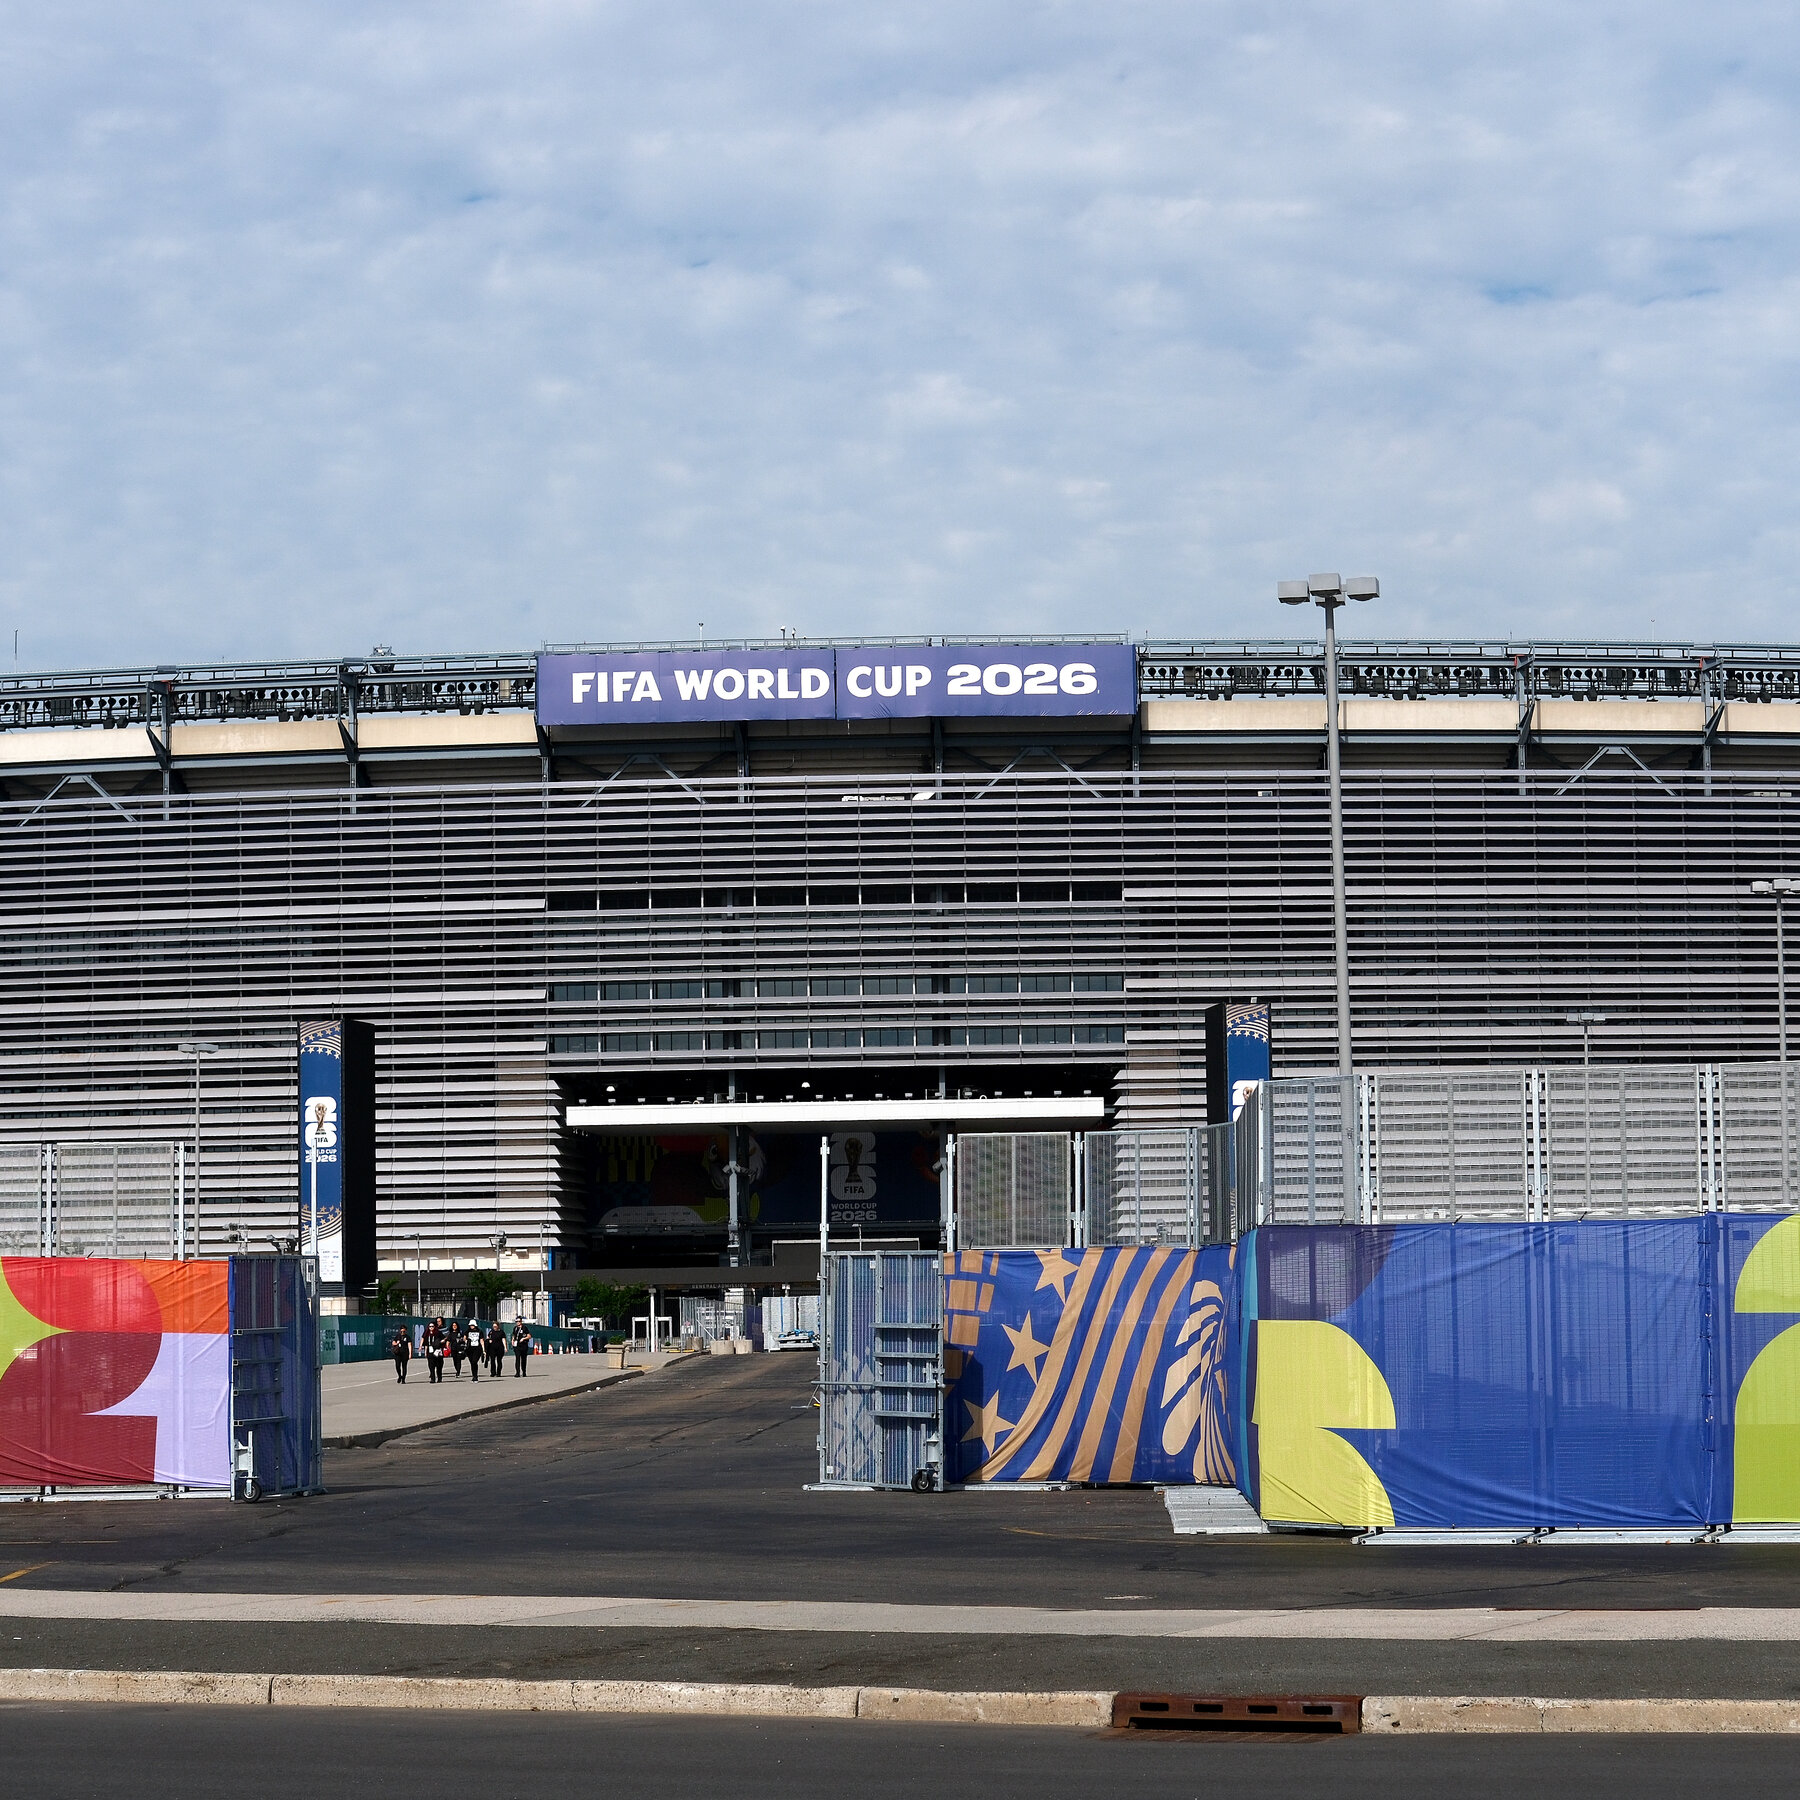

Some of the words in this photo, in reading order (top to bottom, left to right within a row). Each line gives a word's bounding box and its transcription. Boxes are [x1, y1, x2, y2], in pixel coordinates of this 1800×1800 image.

[572, 670, 662, 704] FIFA
[674, 668, 830, 701] WORLD
[846, 665, 932, 698] CUP
[946, 662, 1098, 696] 2026
[844, 1186, 865, 1194] FIFA
[831, 1211, 877, 1221] 2026
